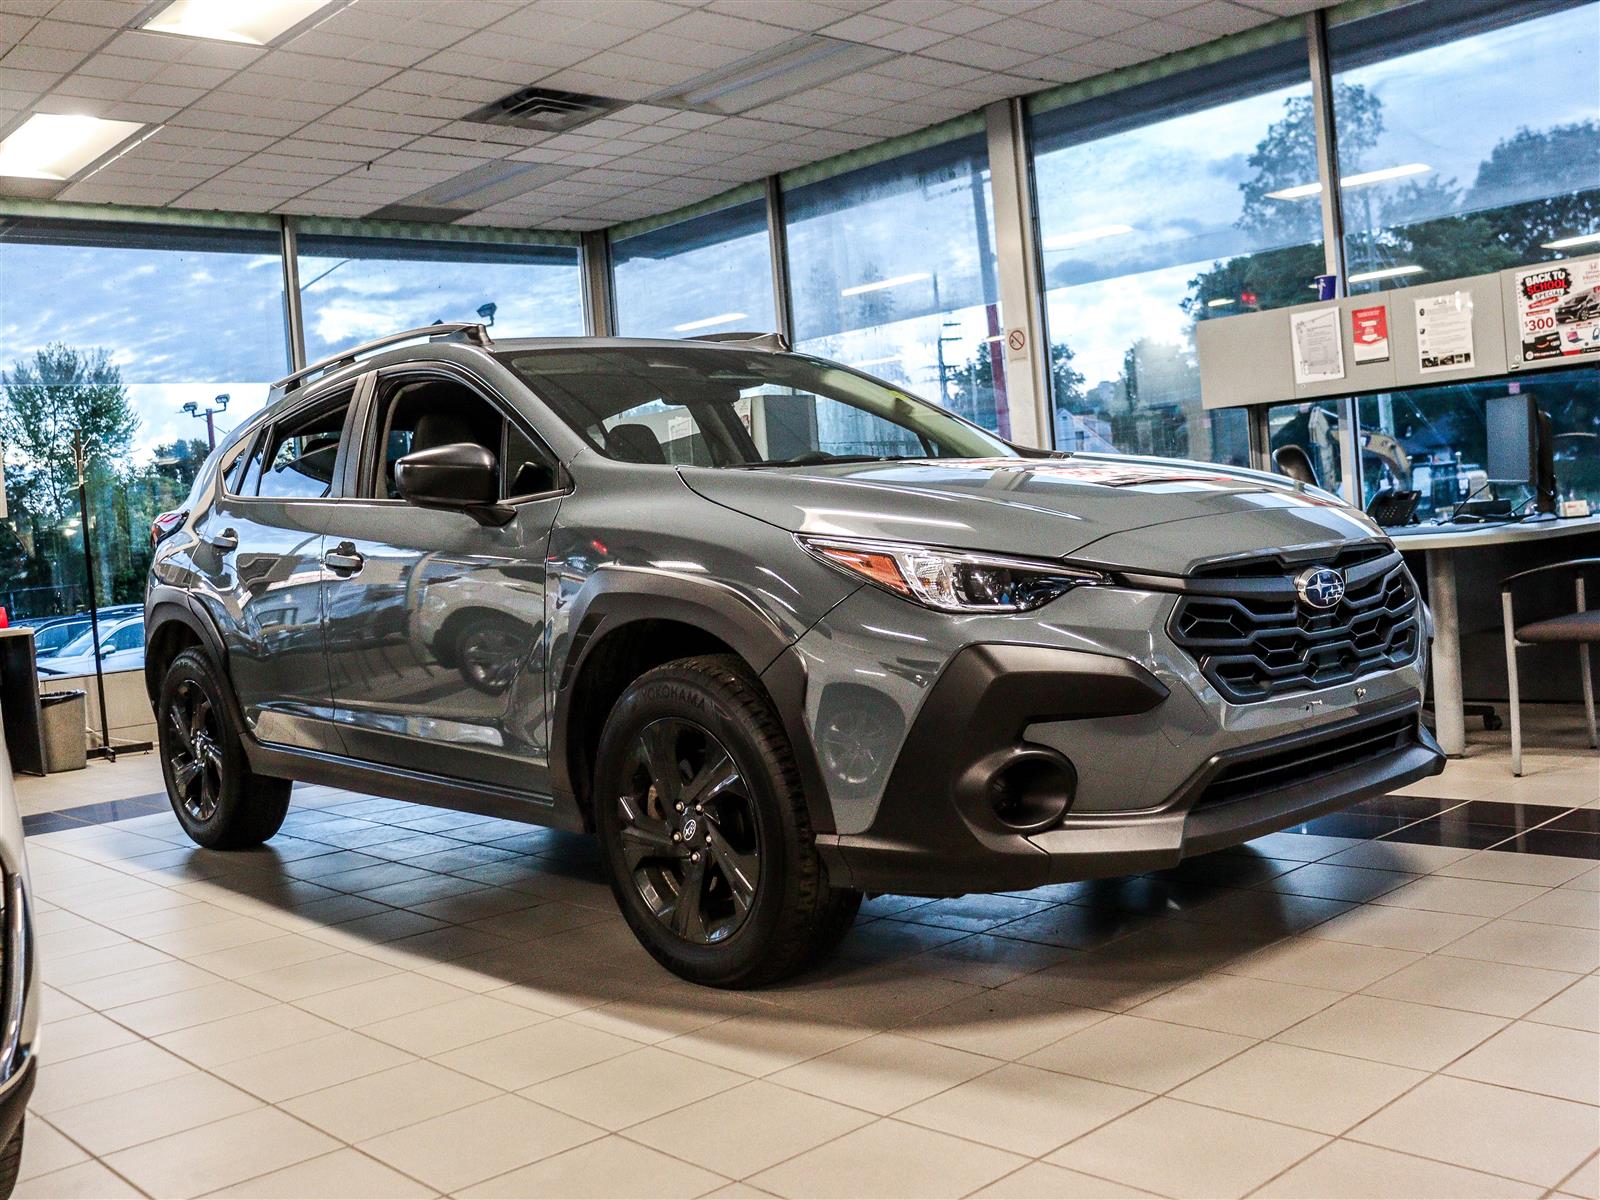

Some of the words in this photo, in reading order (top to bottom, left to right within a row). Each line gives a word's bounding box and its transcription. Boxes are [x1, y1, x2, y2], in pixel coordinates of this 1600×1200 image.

[1525, 272, 1552, 287] BACK
[1552, 270, 1566, 281] TO
[1527, 279, 1568, 295] SCHOOL
[1534, 290, 1562, 300] SPECIAL
[641, 684, 705, 712] YOKOHAMA
